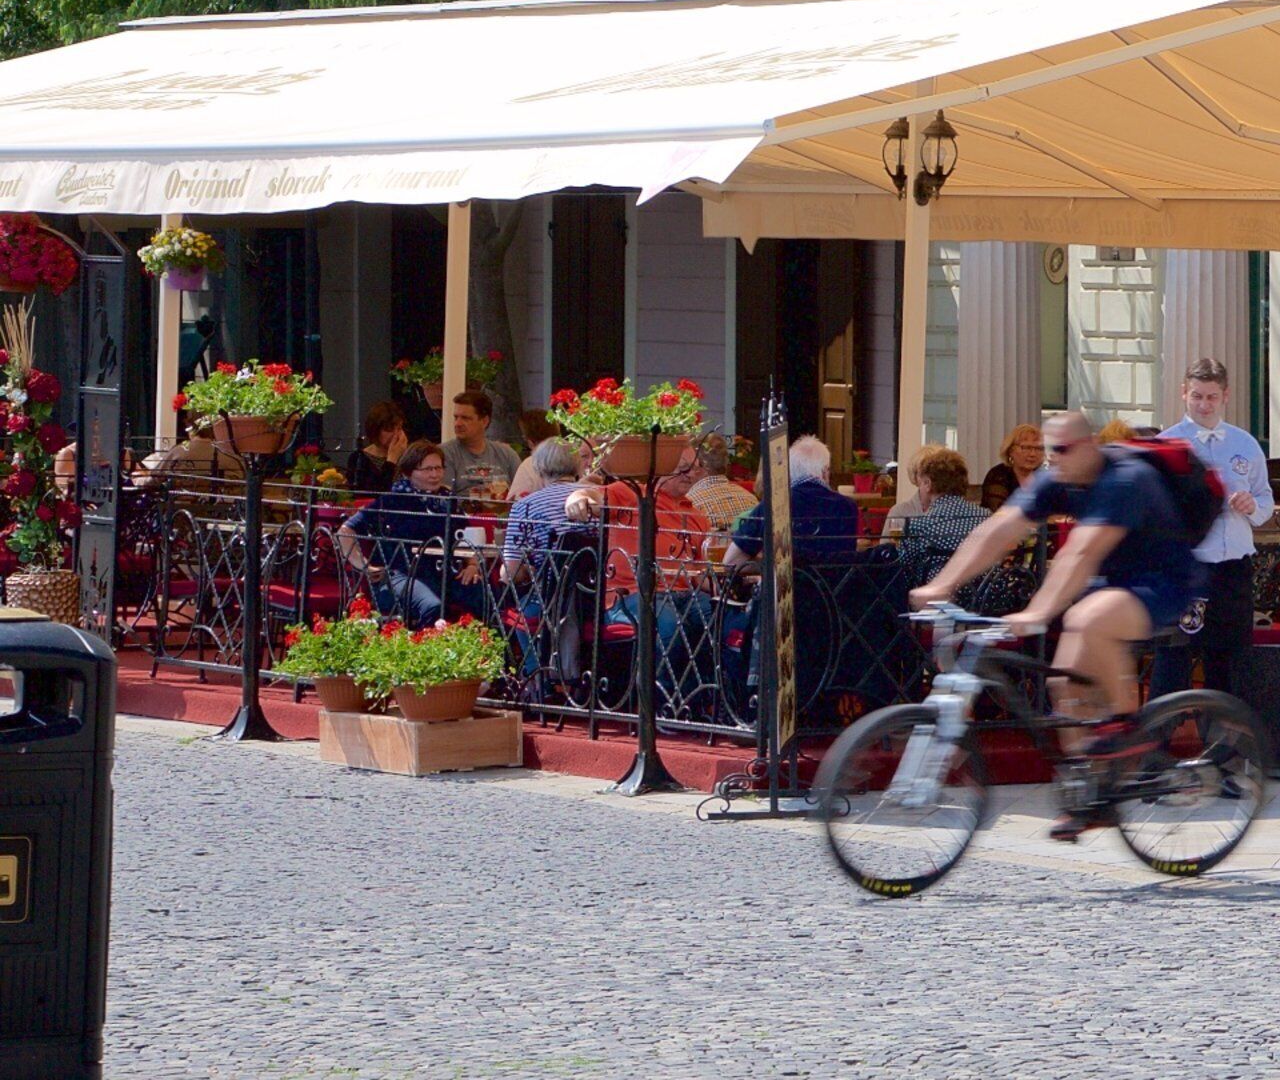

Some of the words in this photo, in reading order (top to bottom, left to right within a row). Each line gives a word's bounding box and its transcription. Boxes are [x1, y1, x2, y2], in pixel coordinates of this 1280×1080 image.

[164, 167, 251, 207] Original
[264, 165, 332, 198] slovak
[342, 163, 472, 191] retaurant
